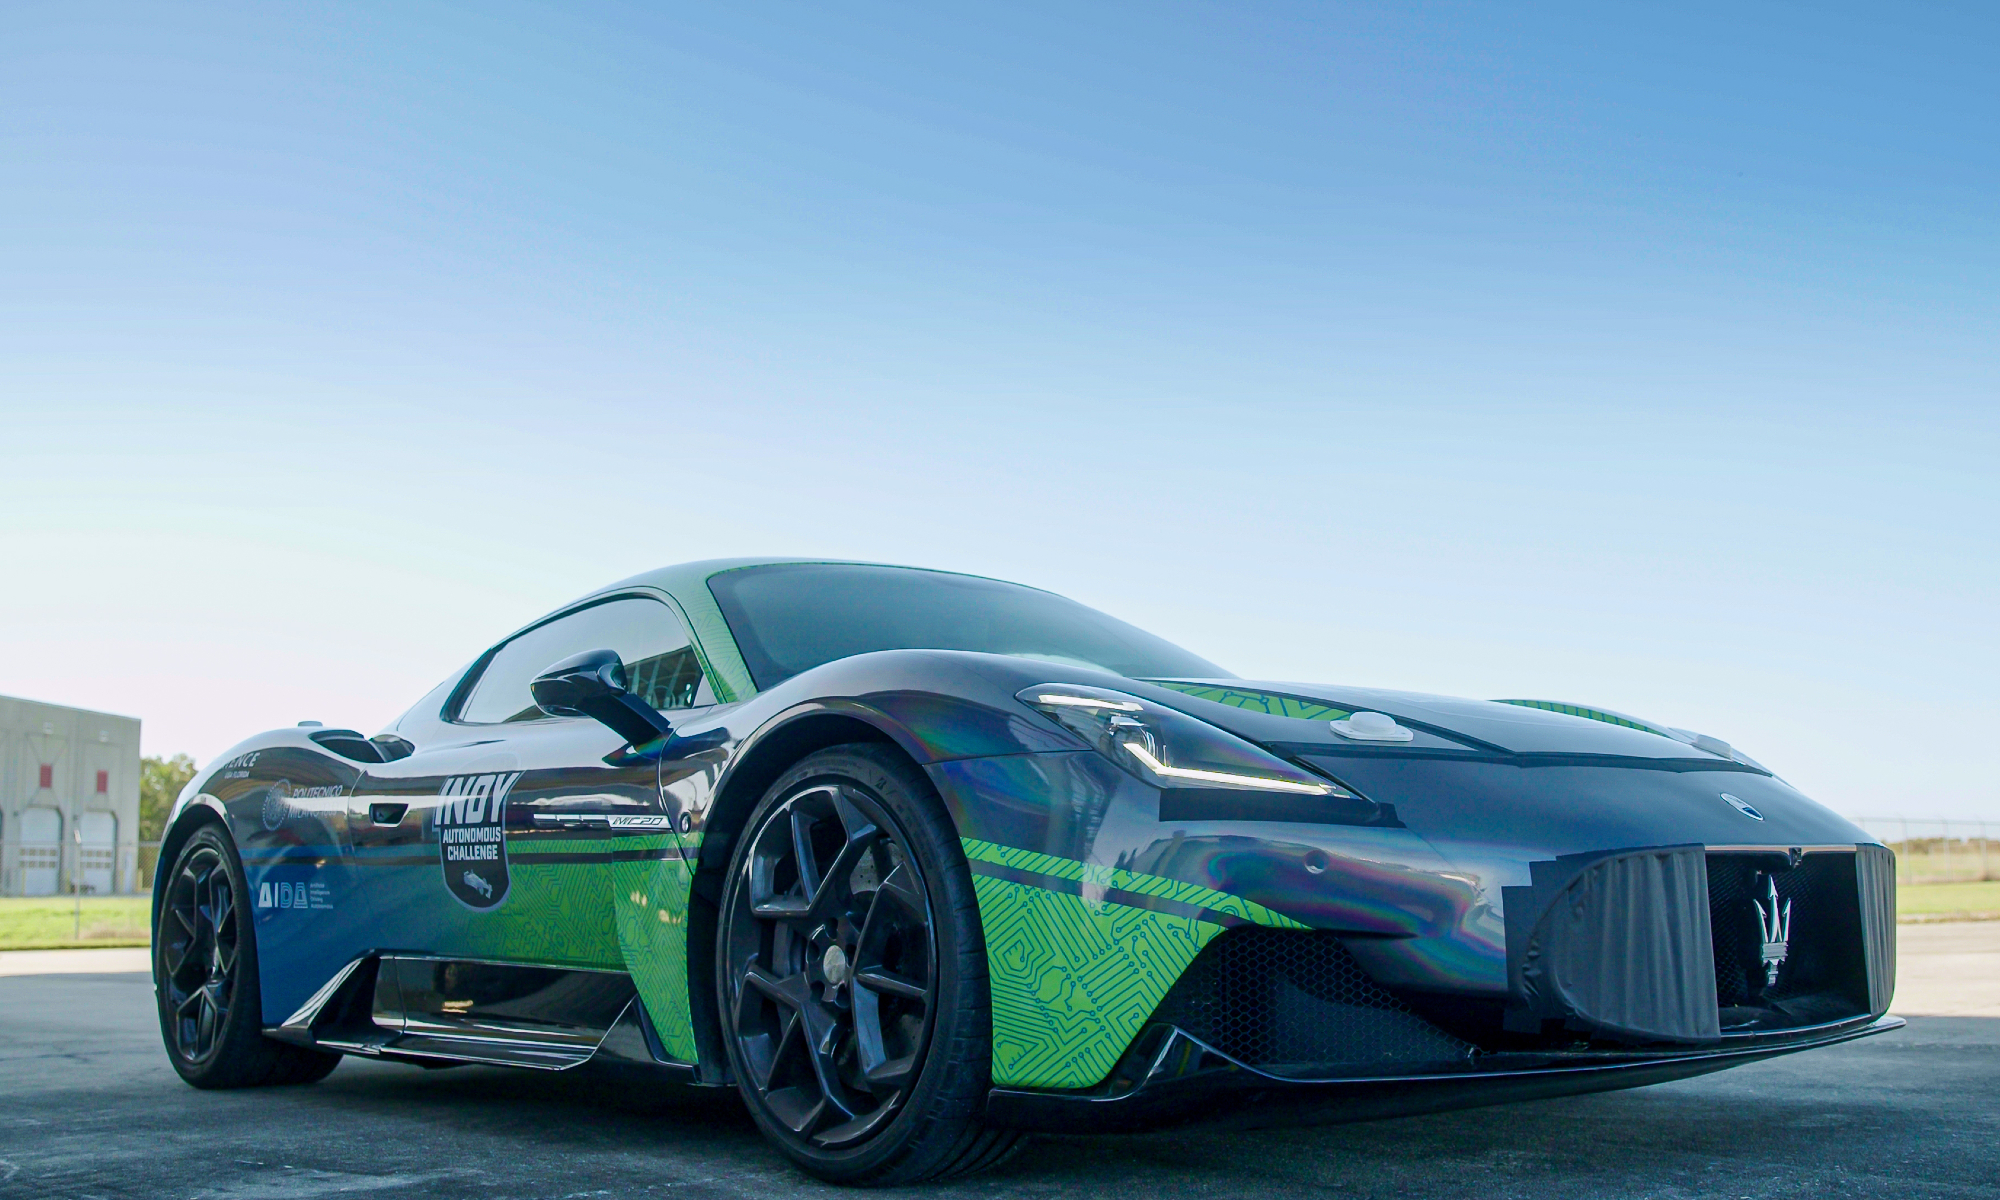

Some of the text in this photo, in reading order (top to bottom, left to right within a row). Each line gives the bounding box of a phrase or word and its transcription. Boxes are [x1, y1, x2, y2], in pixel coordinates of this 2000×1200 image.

[434, 772, 521, 826] INDY
[613, 816, 664, 826] MC20
[443, 826, 501, 844] AUTONOMOUS
[447, 844, 498, 861] CHALLENGE
[258, 882, 309, 909] AIDA
